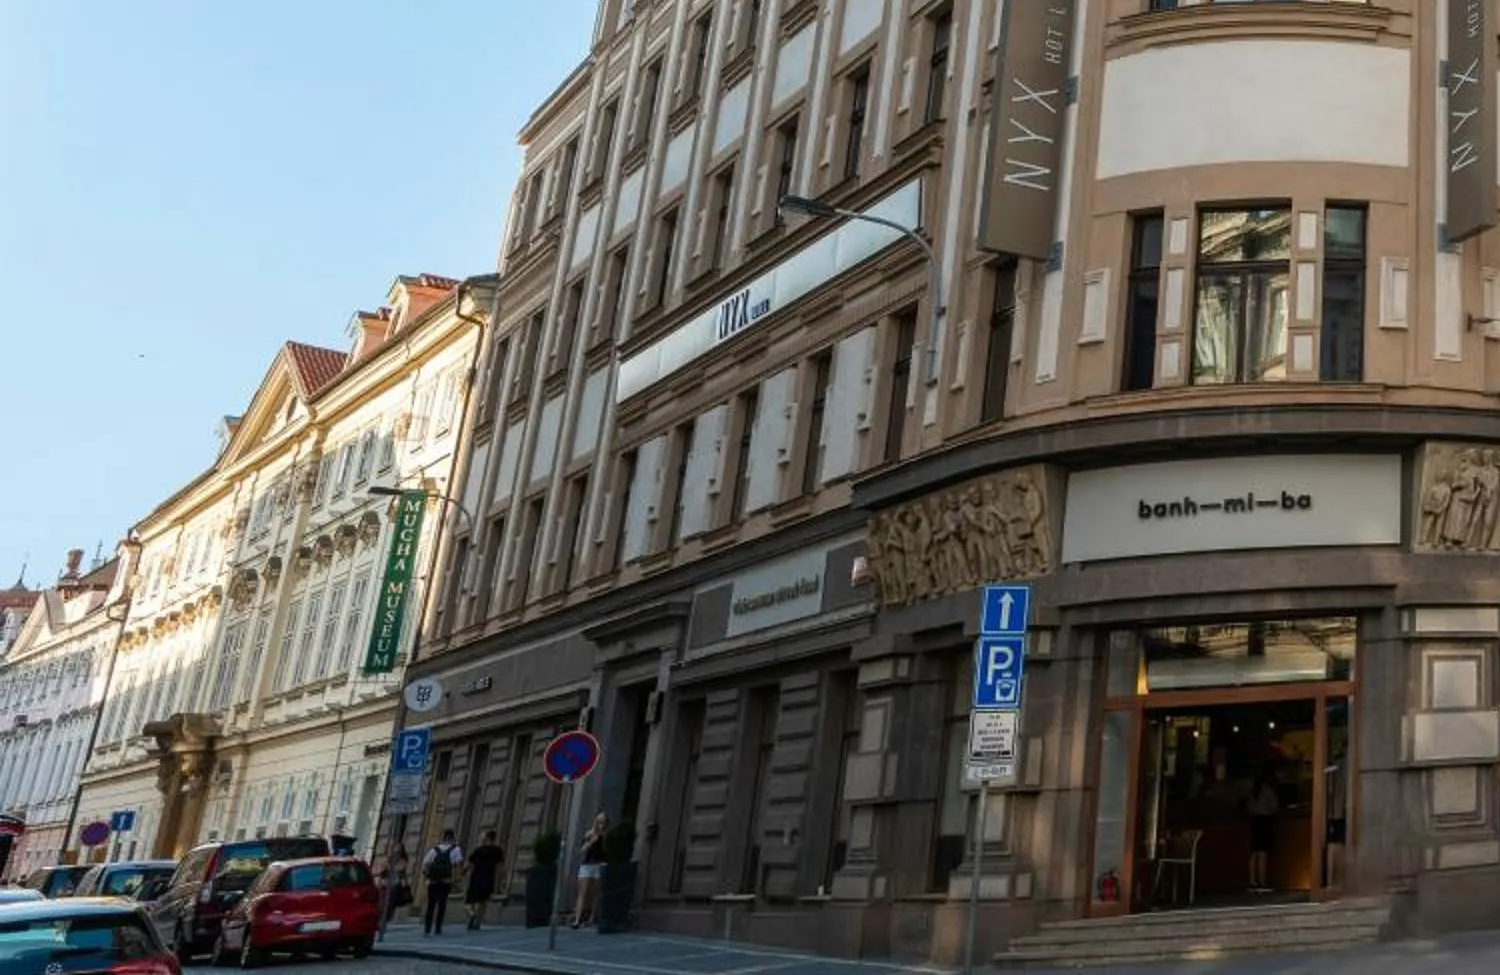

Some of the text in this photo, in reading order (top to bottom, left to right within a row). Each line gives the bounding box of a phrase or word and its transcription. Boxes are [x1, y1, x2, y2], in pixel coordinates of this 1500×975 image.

[1003, 7, 1067, 191] NYX HOTL
[1451, 57, 1480, 173] NYX
[719, 289, 750, 340] NYX
[372, 500, 421, 667] MUCHA MUSEUM
[986, 646, 1014, 685] P
[402, 735, 422, 759] P
